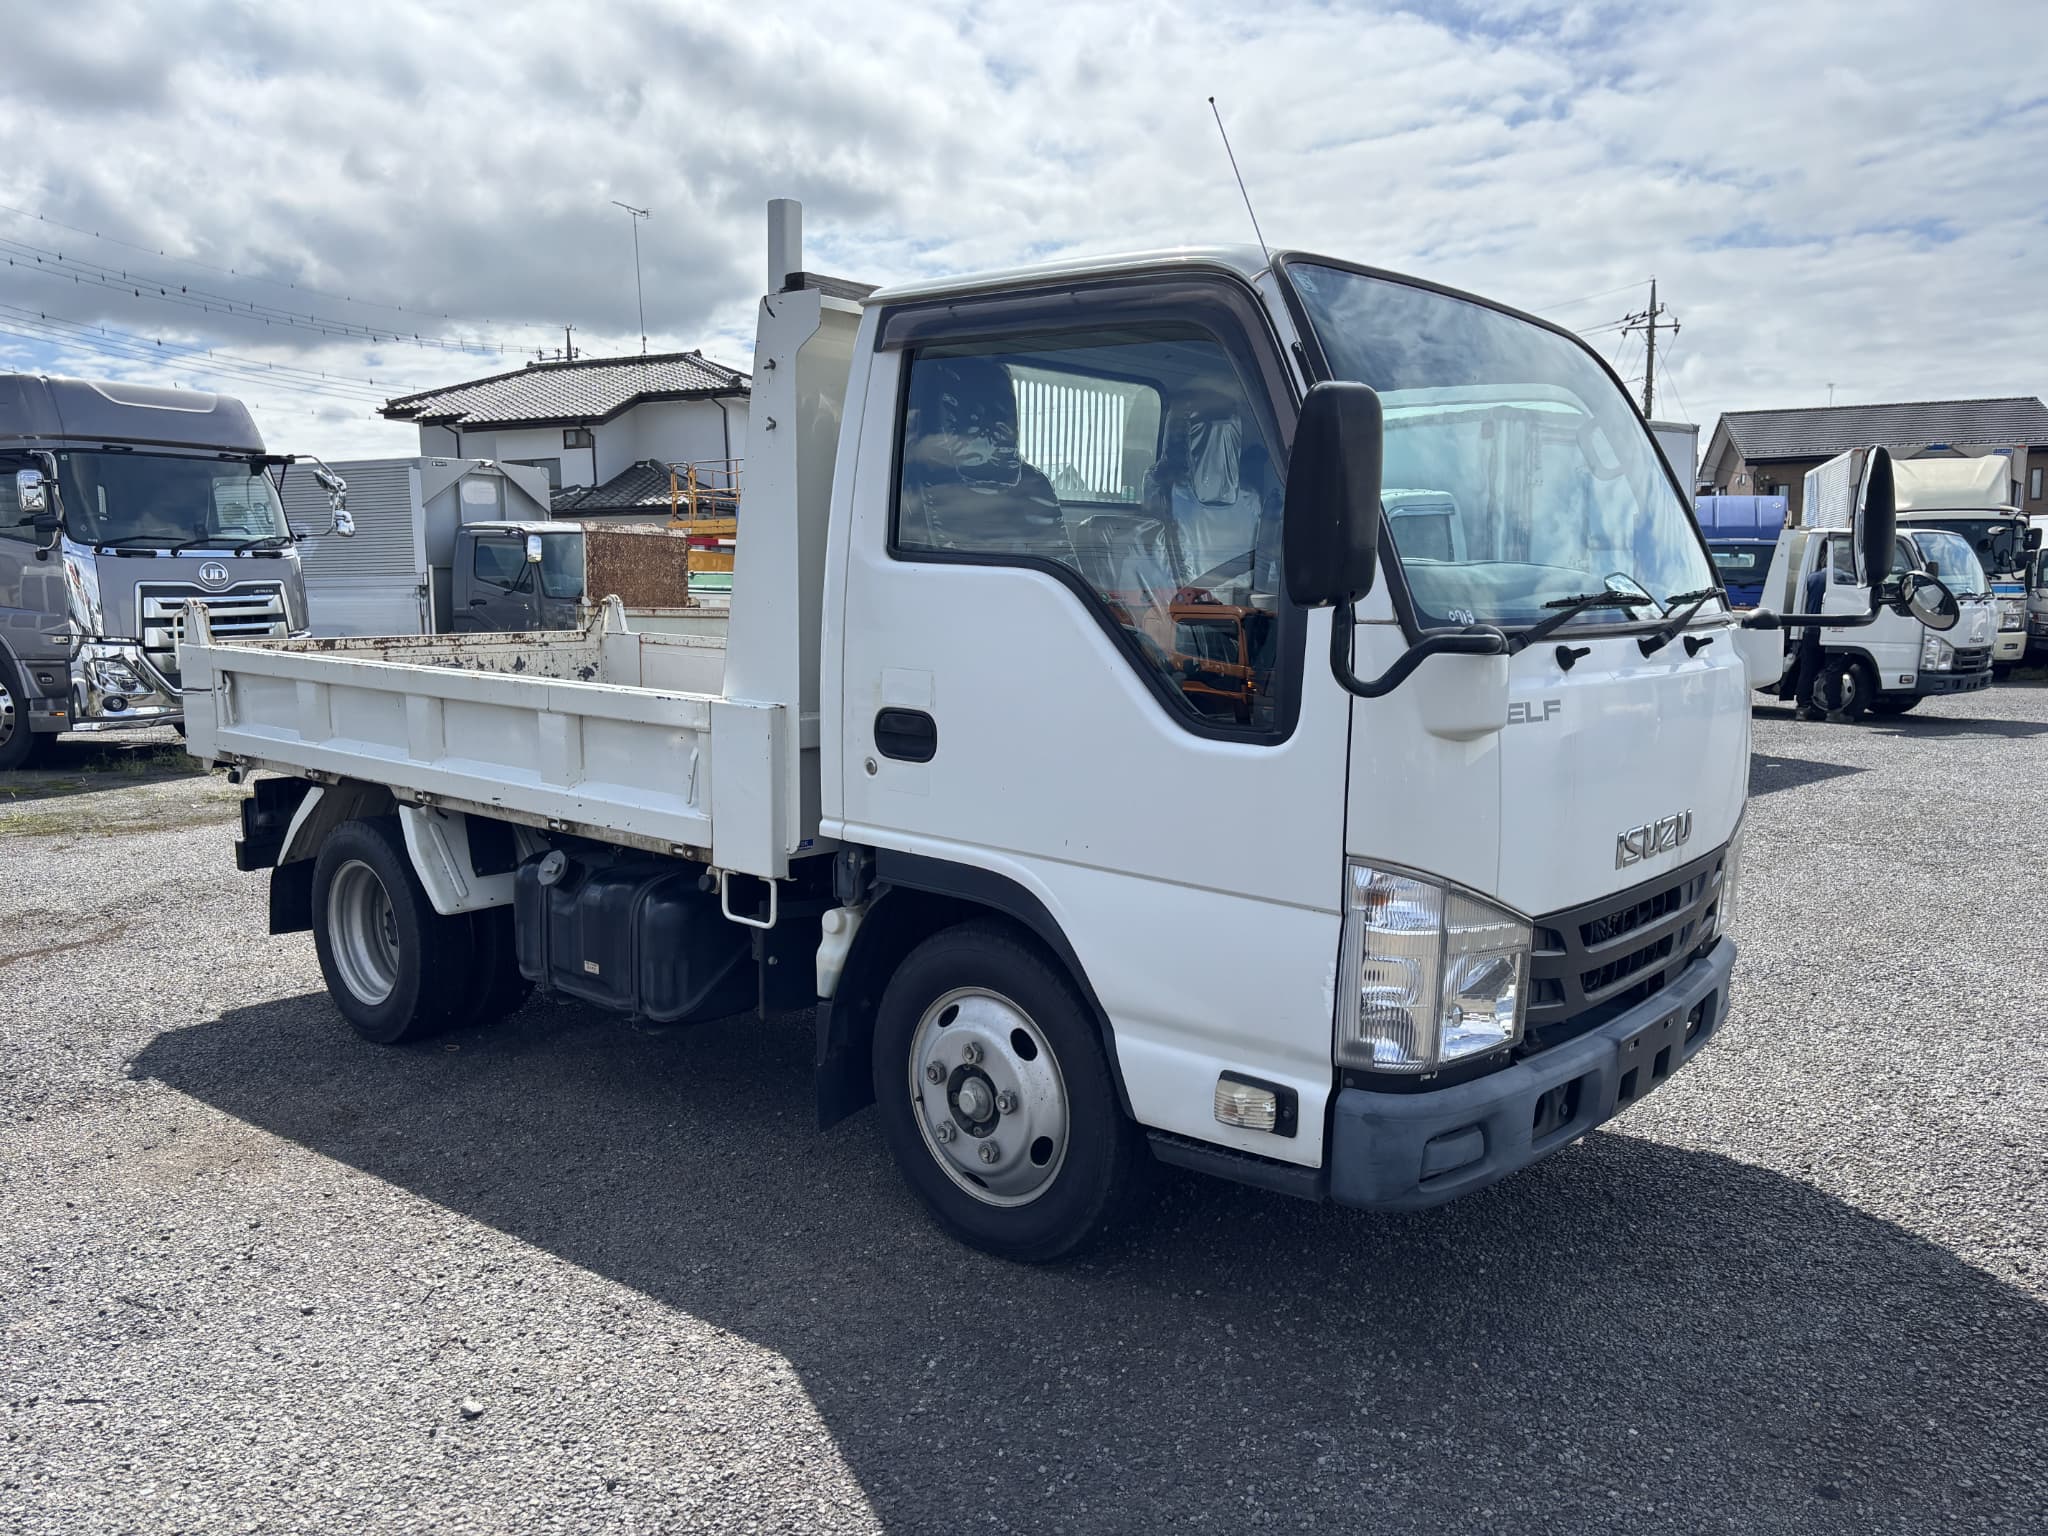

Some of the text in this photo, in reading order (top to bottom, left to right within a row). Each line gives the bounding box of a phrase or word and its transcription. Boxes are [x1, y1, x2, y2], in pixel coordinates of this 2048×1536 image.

[202, 568, 226, 580] UD
[1507, 699, 1561, 725] ELF
[1615, 808, 1693, 870] ISUZU
